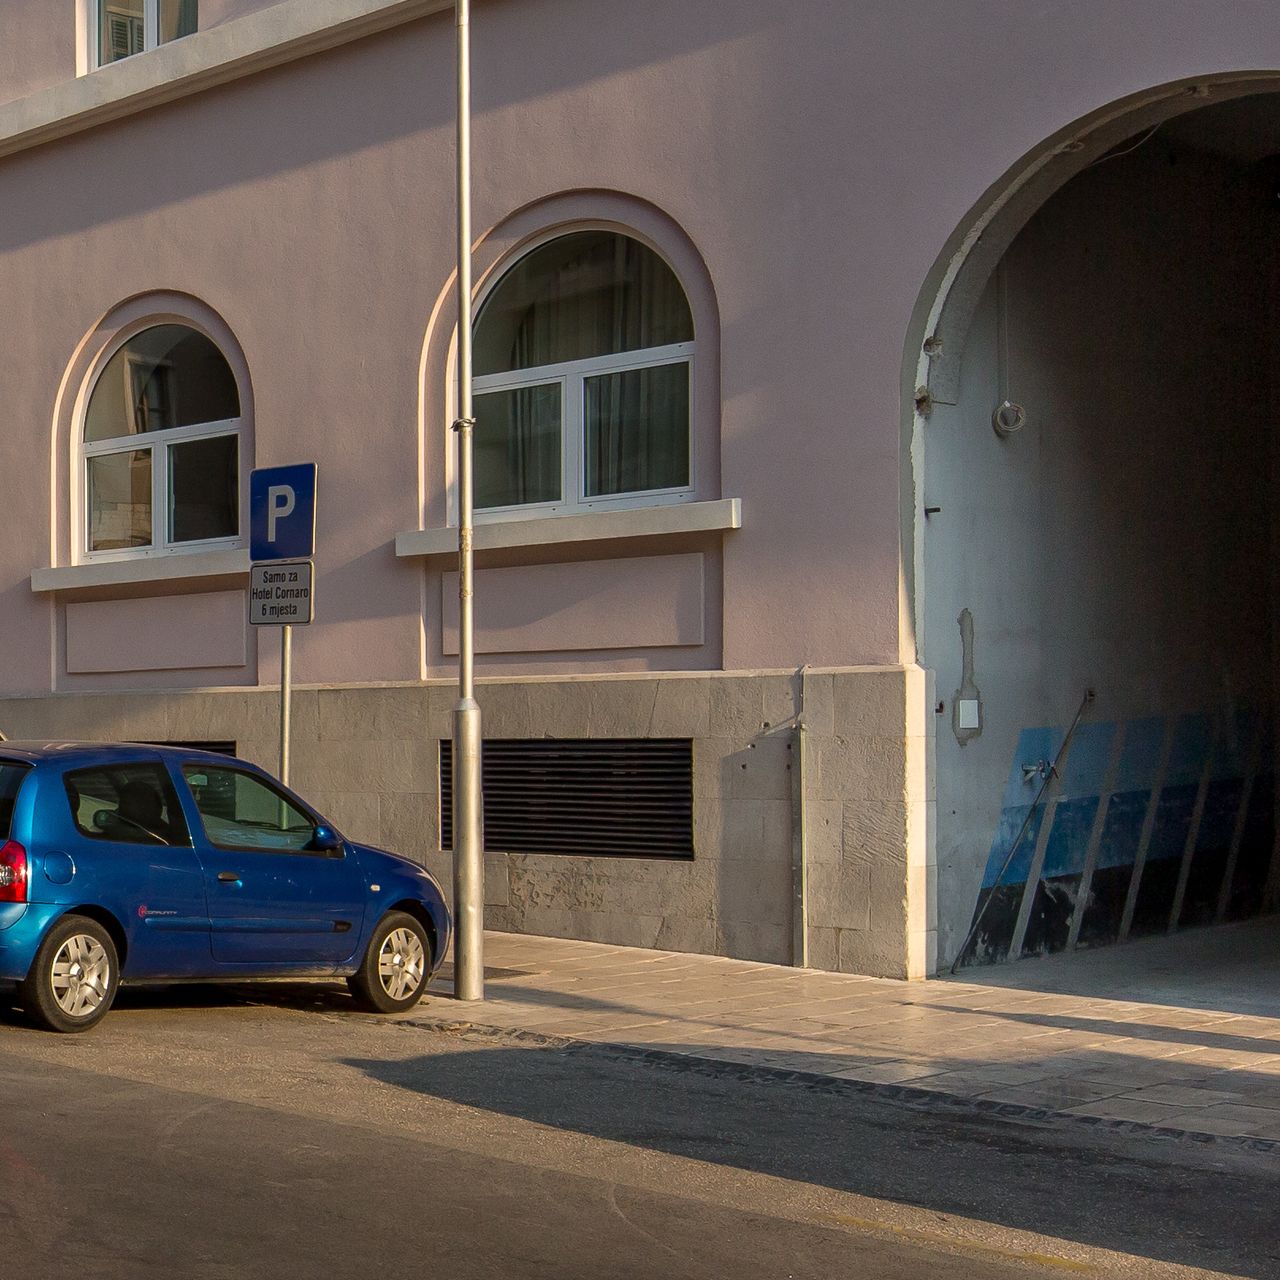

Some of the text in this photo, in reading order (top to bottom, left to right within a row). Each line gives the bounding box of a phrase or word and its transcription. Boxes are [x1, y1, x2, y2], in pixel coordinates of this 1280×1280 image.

[267, 484, 296, 543] P
[263, 570, 298, 584] Samo za
[252, 586, 309, 600] Hotel Cornaro
[261, 603, 298, 618] 6 mjesta
